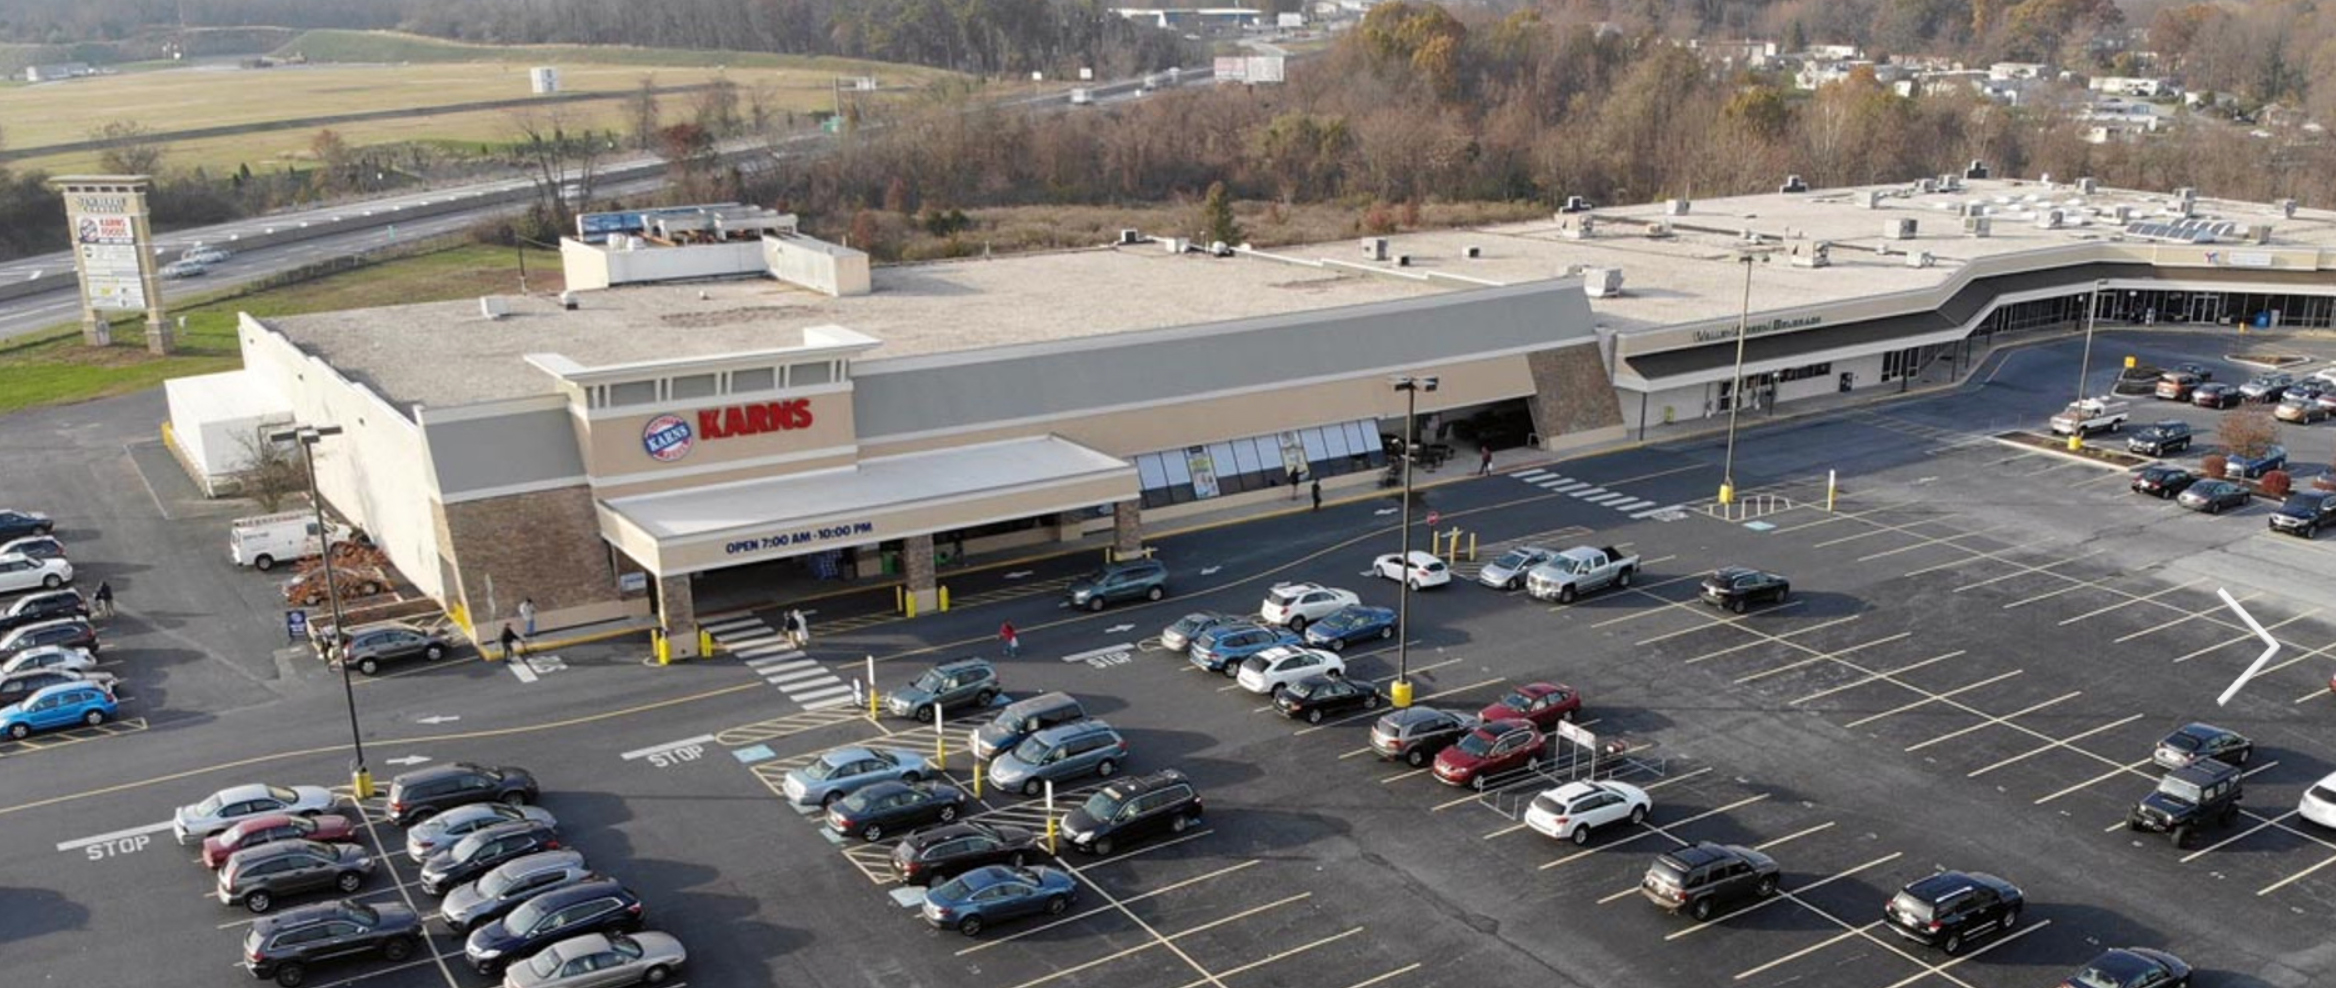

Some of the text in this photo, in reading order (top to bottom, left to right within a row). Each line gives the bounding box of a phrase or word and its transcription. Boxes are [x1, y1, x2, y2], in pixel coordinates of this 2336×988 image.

[698, 398, 813, 440] KARNS
[648, 423, 689, 452] KARNS
[726, 540, 759, 554] OPEN
[762, 534, 789, 549] 7:00
[792, 531, 811, 544] AM
[819, 526, 851, 540] 10:00
[854, 522, 873, 534] PM
[648, 744, 704, 768] STOP
[86, 835, 150, 860] STOP
